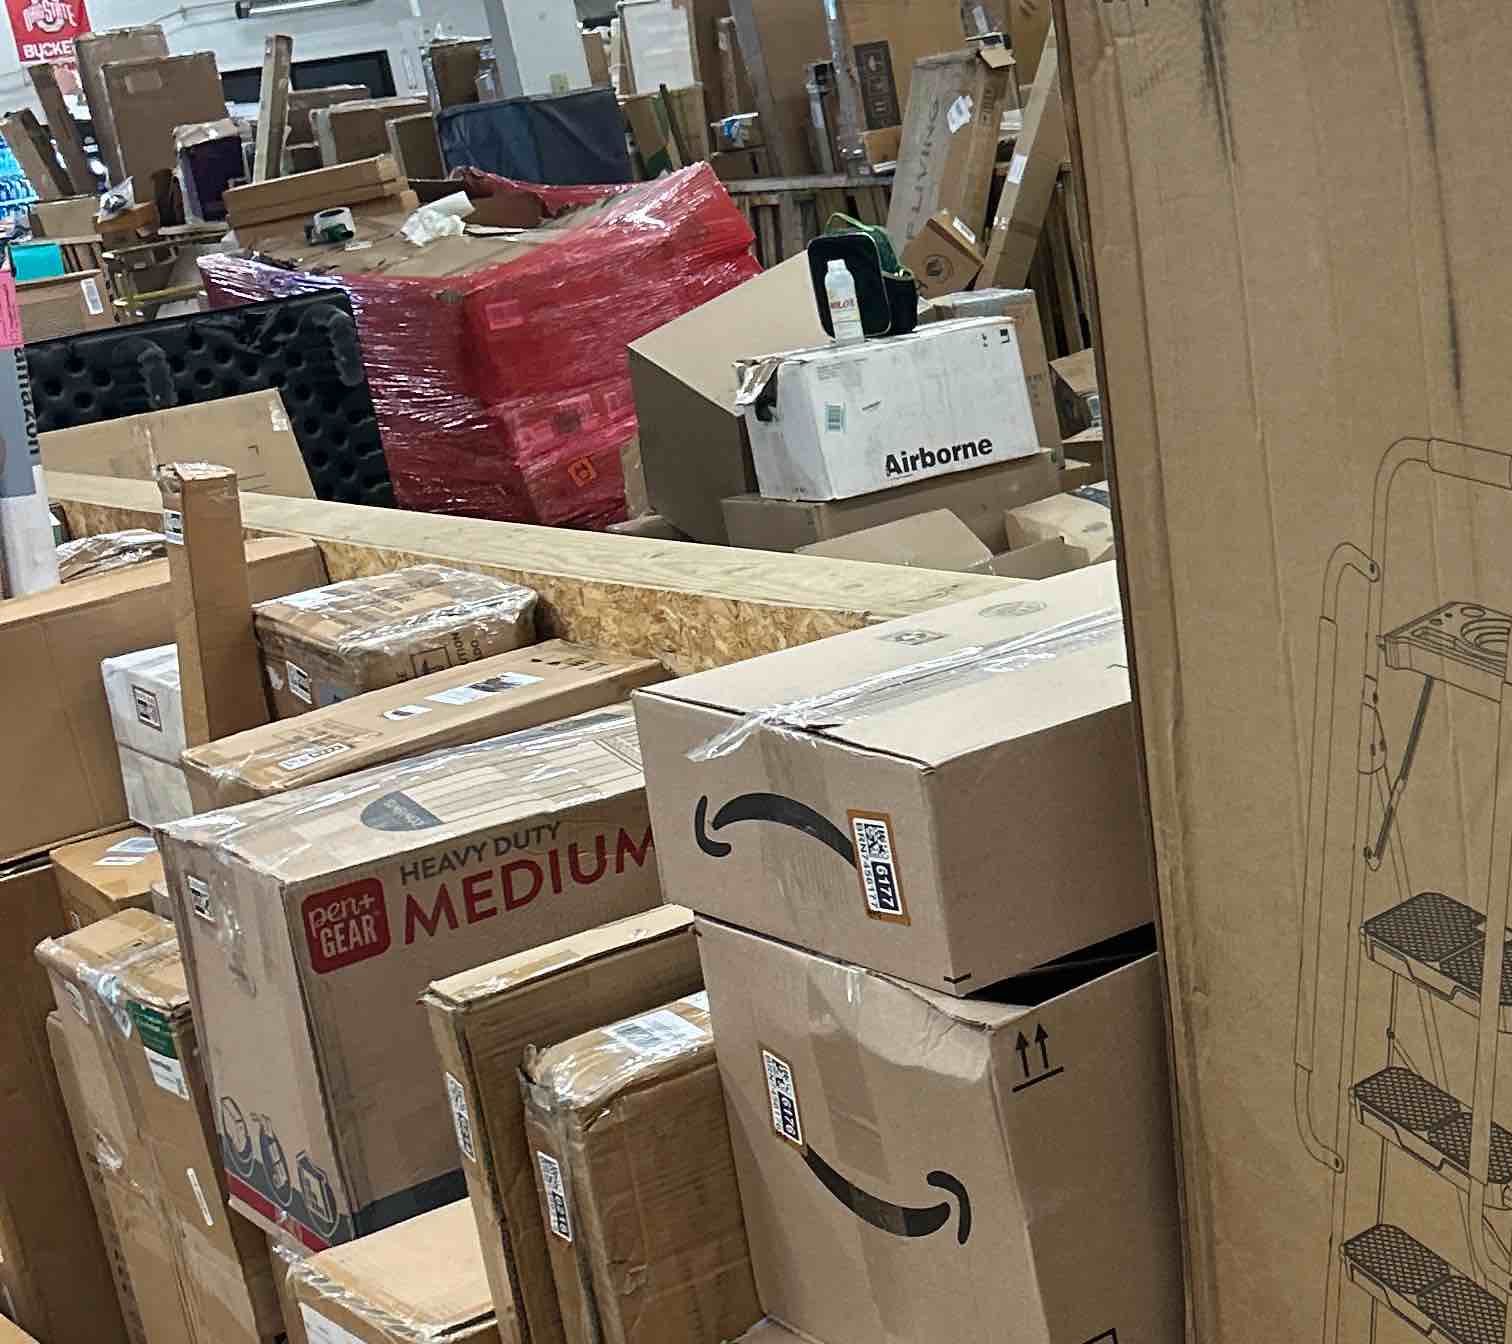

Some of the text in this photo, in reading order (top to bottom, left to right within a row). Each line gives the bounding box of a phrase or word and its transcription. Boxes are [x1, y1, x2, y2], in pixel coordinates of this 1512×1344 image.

[22, 38, 77, 61] BUCKE
[884, 436, 993, 479] Airborne
[400, 821, 563, 886] HEAVY DUTY
[404, 824, 656, 946] MEDIUM
[876, 864, 895, 908] 6177
[319, 913, 379, 959] GEAR
